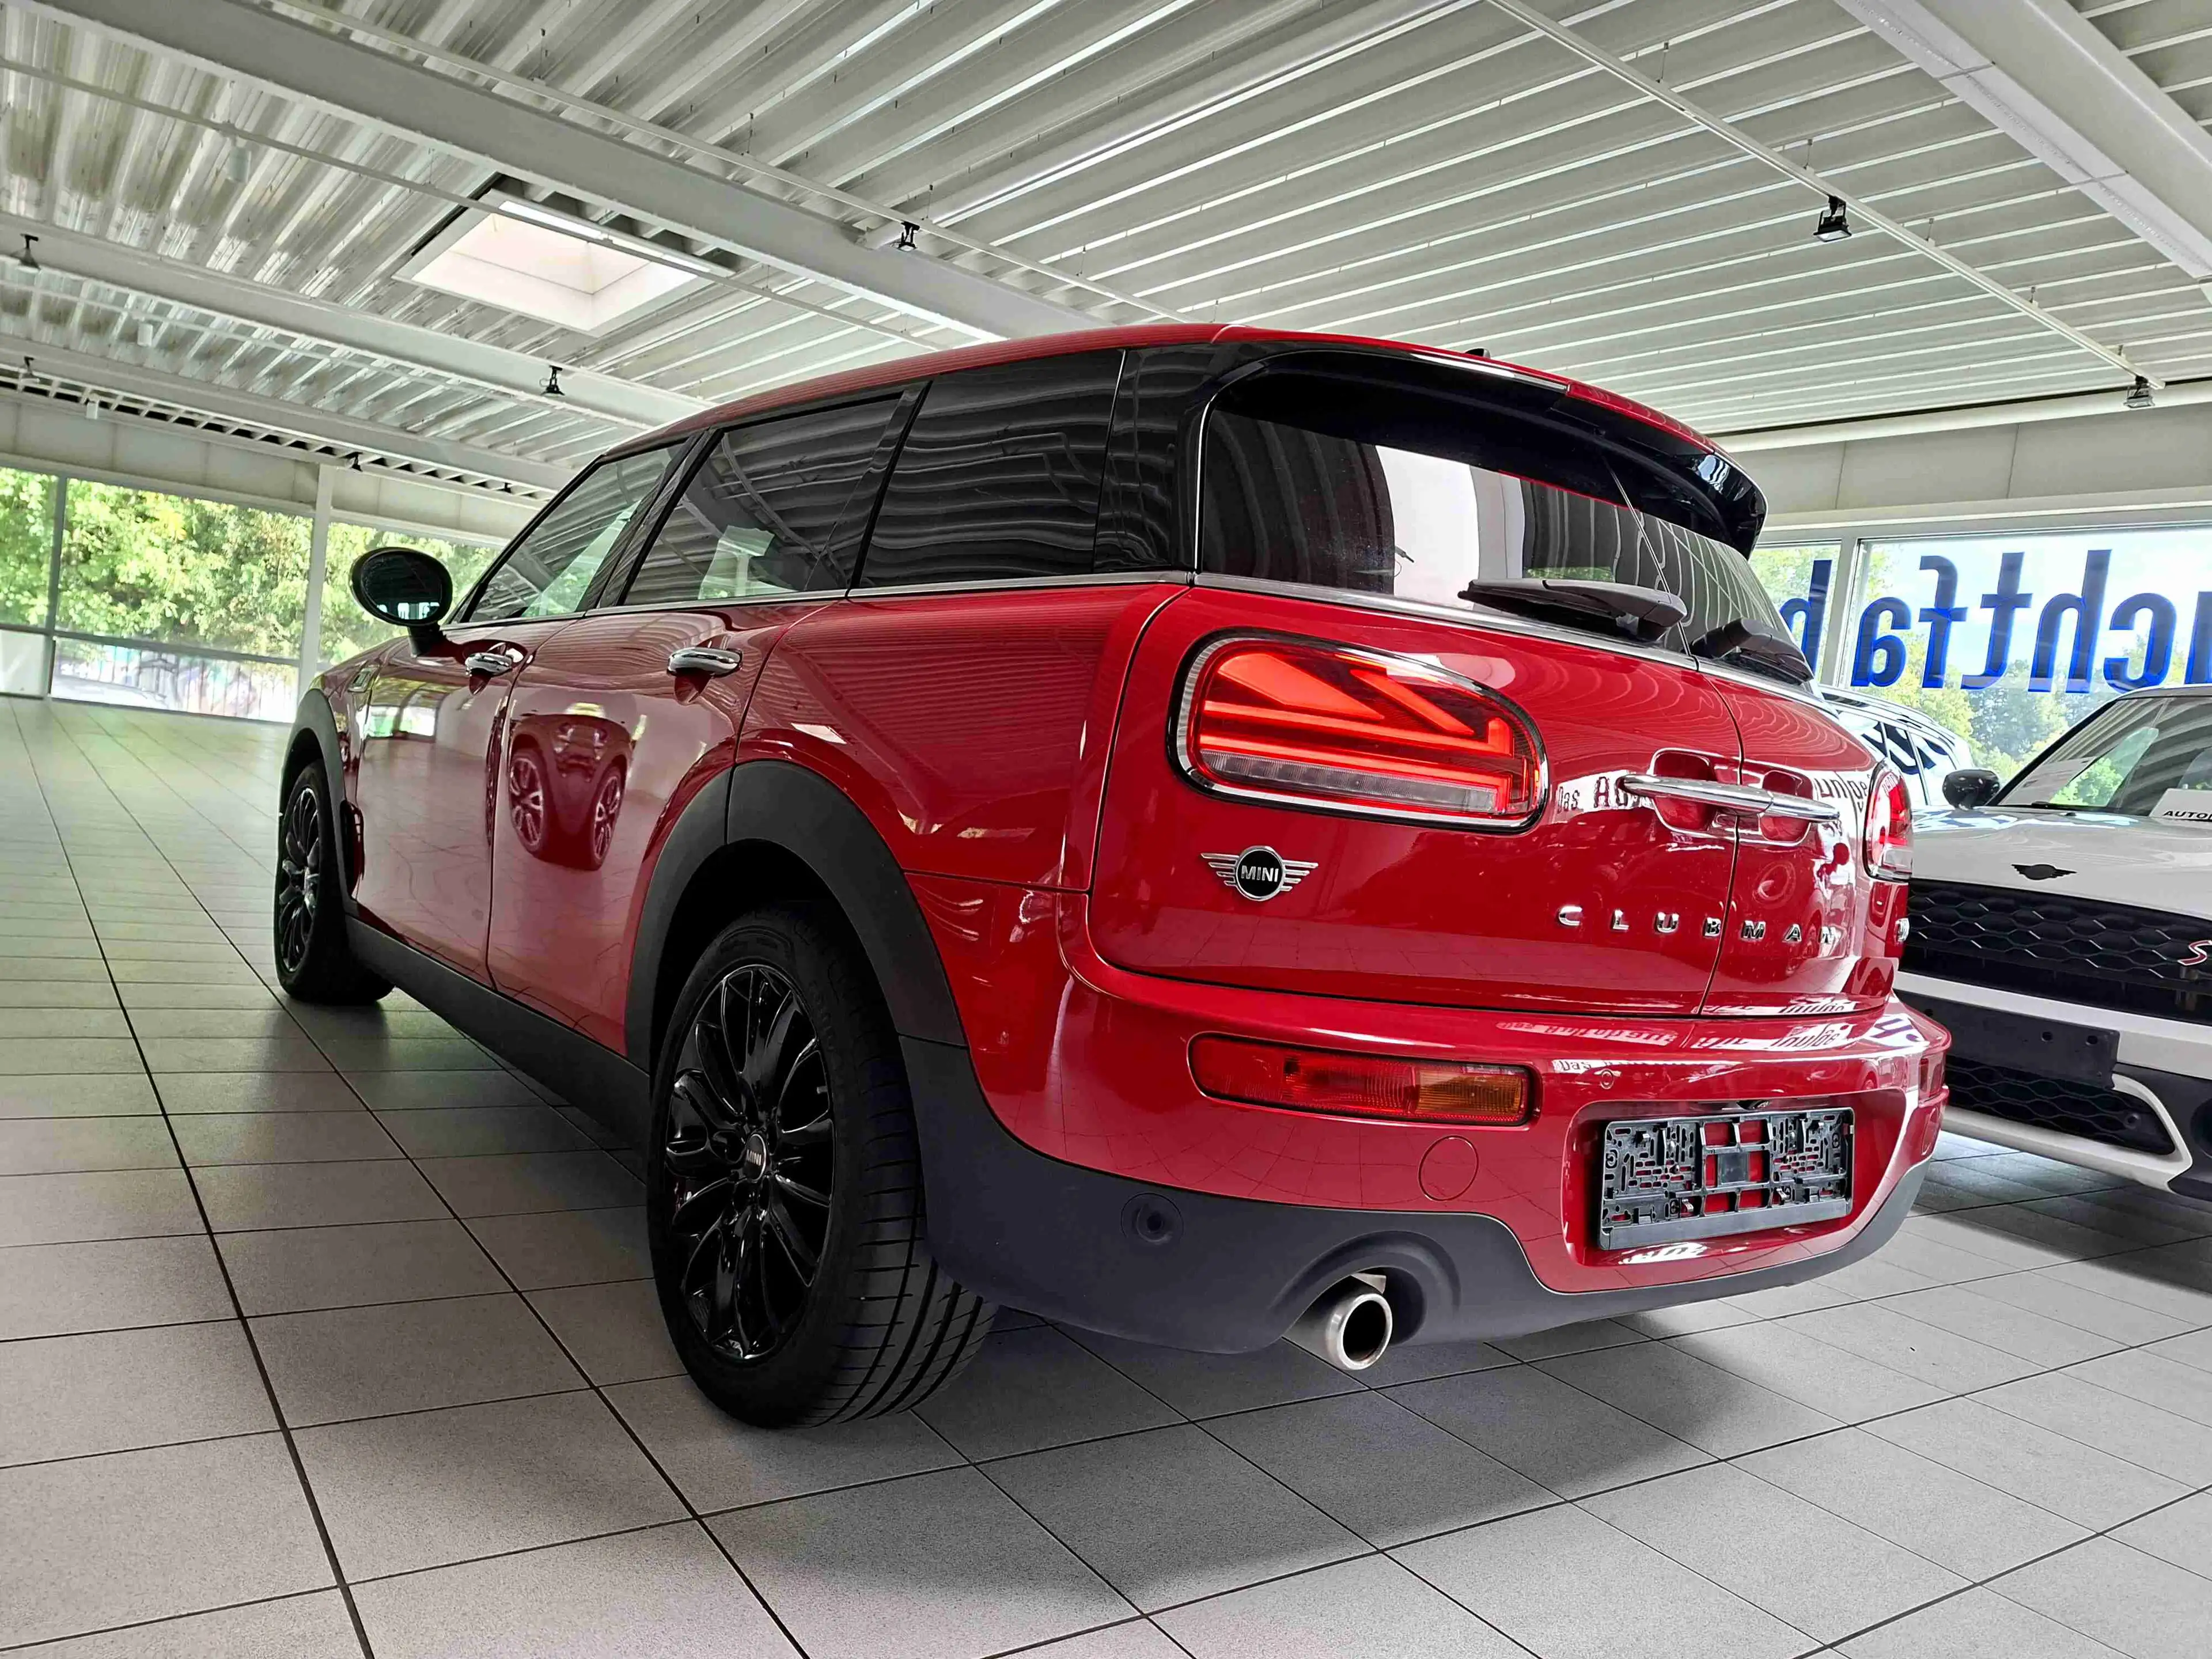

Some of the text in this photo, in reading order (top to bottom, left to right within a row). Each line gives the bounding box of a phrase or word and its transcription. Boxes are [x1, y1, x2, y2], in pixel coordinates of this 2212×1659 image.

[2162, 810, 2212, 820] AUTO
[1241, 865, 1279, 882] MINI
[1558, 905, 1838, 944] CLUBMAN
[2177, 940, 2212, 965] S
[747, 1149, 762, 1166] MINI
